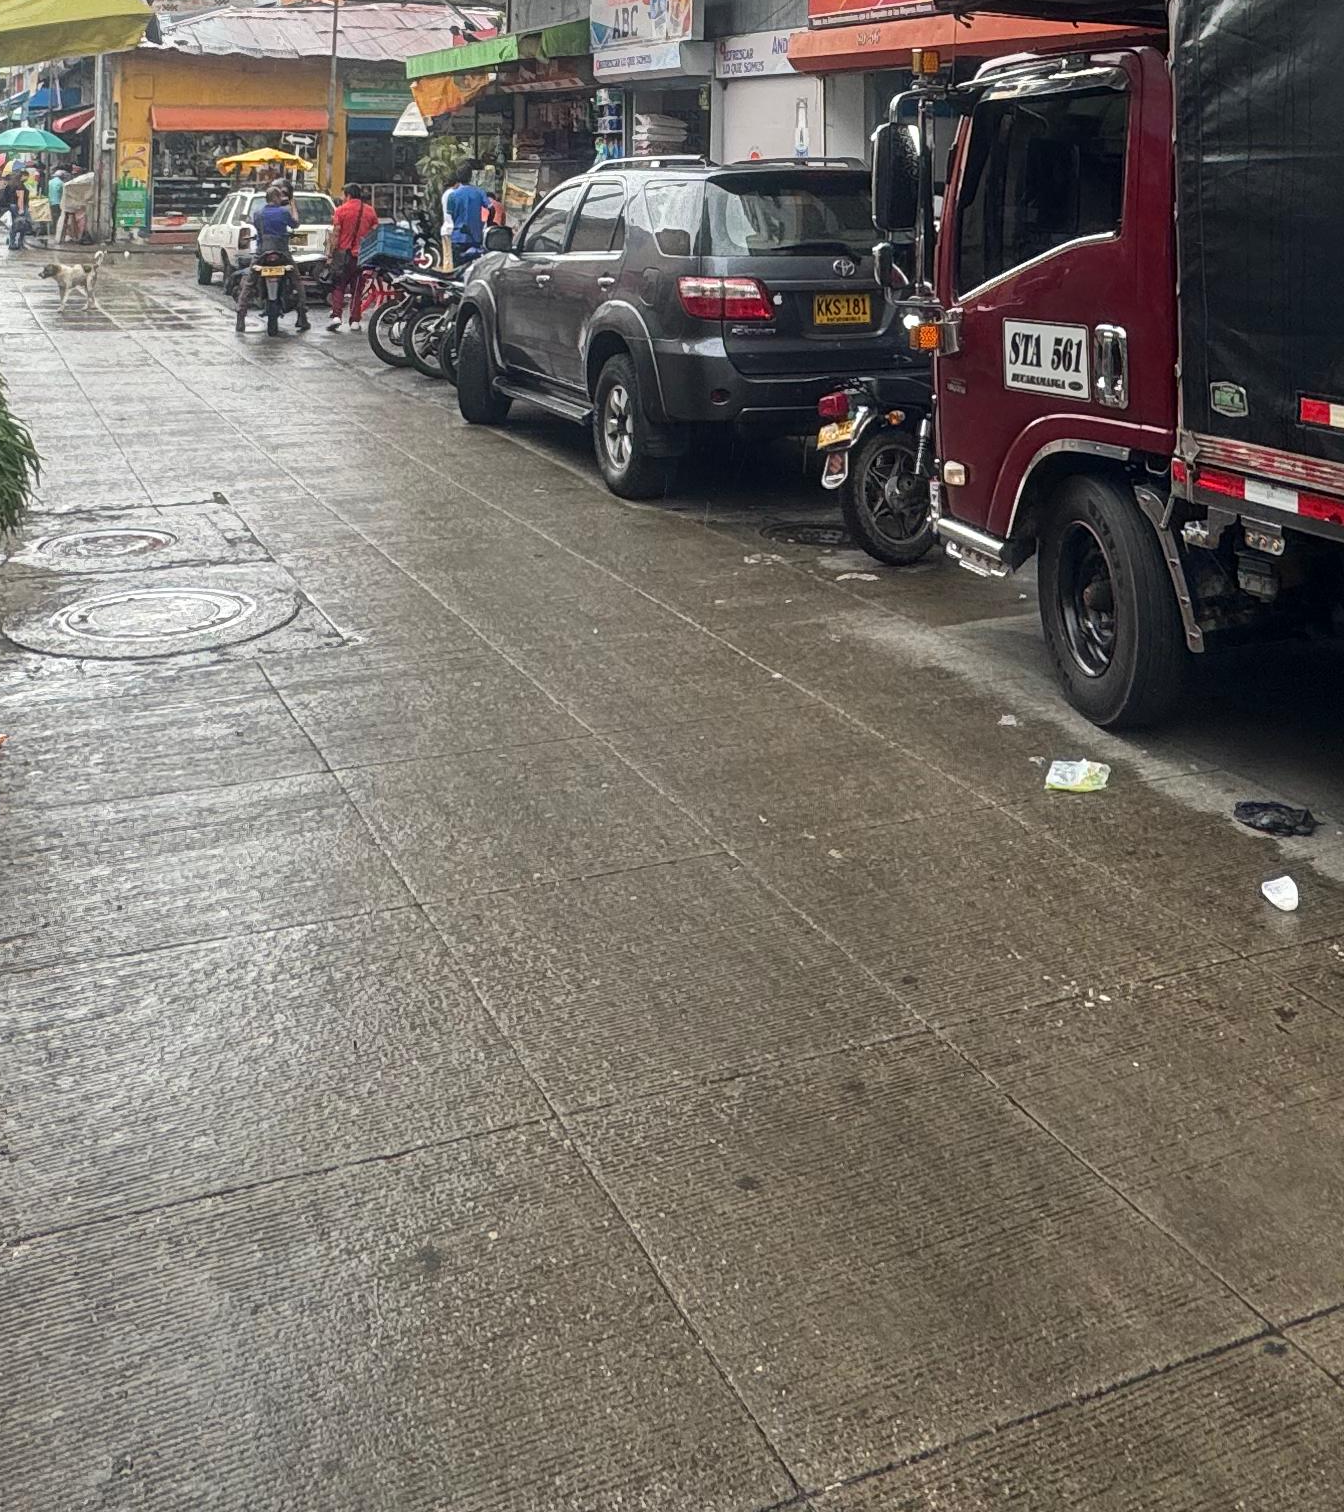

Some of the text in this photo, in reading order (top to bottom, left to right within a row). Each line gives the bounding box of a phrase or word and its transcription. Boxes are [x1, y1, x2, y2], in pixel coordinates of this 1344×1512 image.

[612, 5, 638, 39] ABC
[1009, 332, 1083, 373] STA 561
